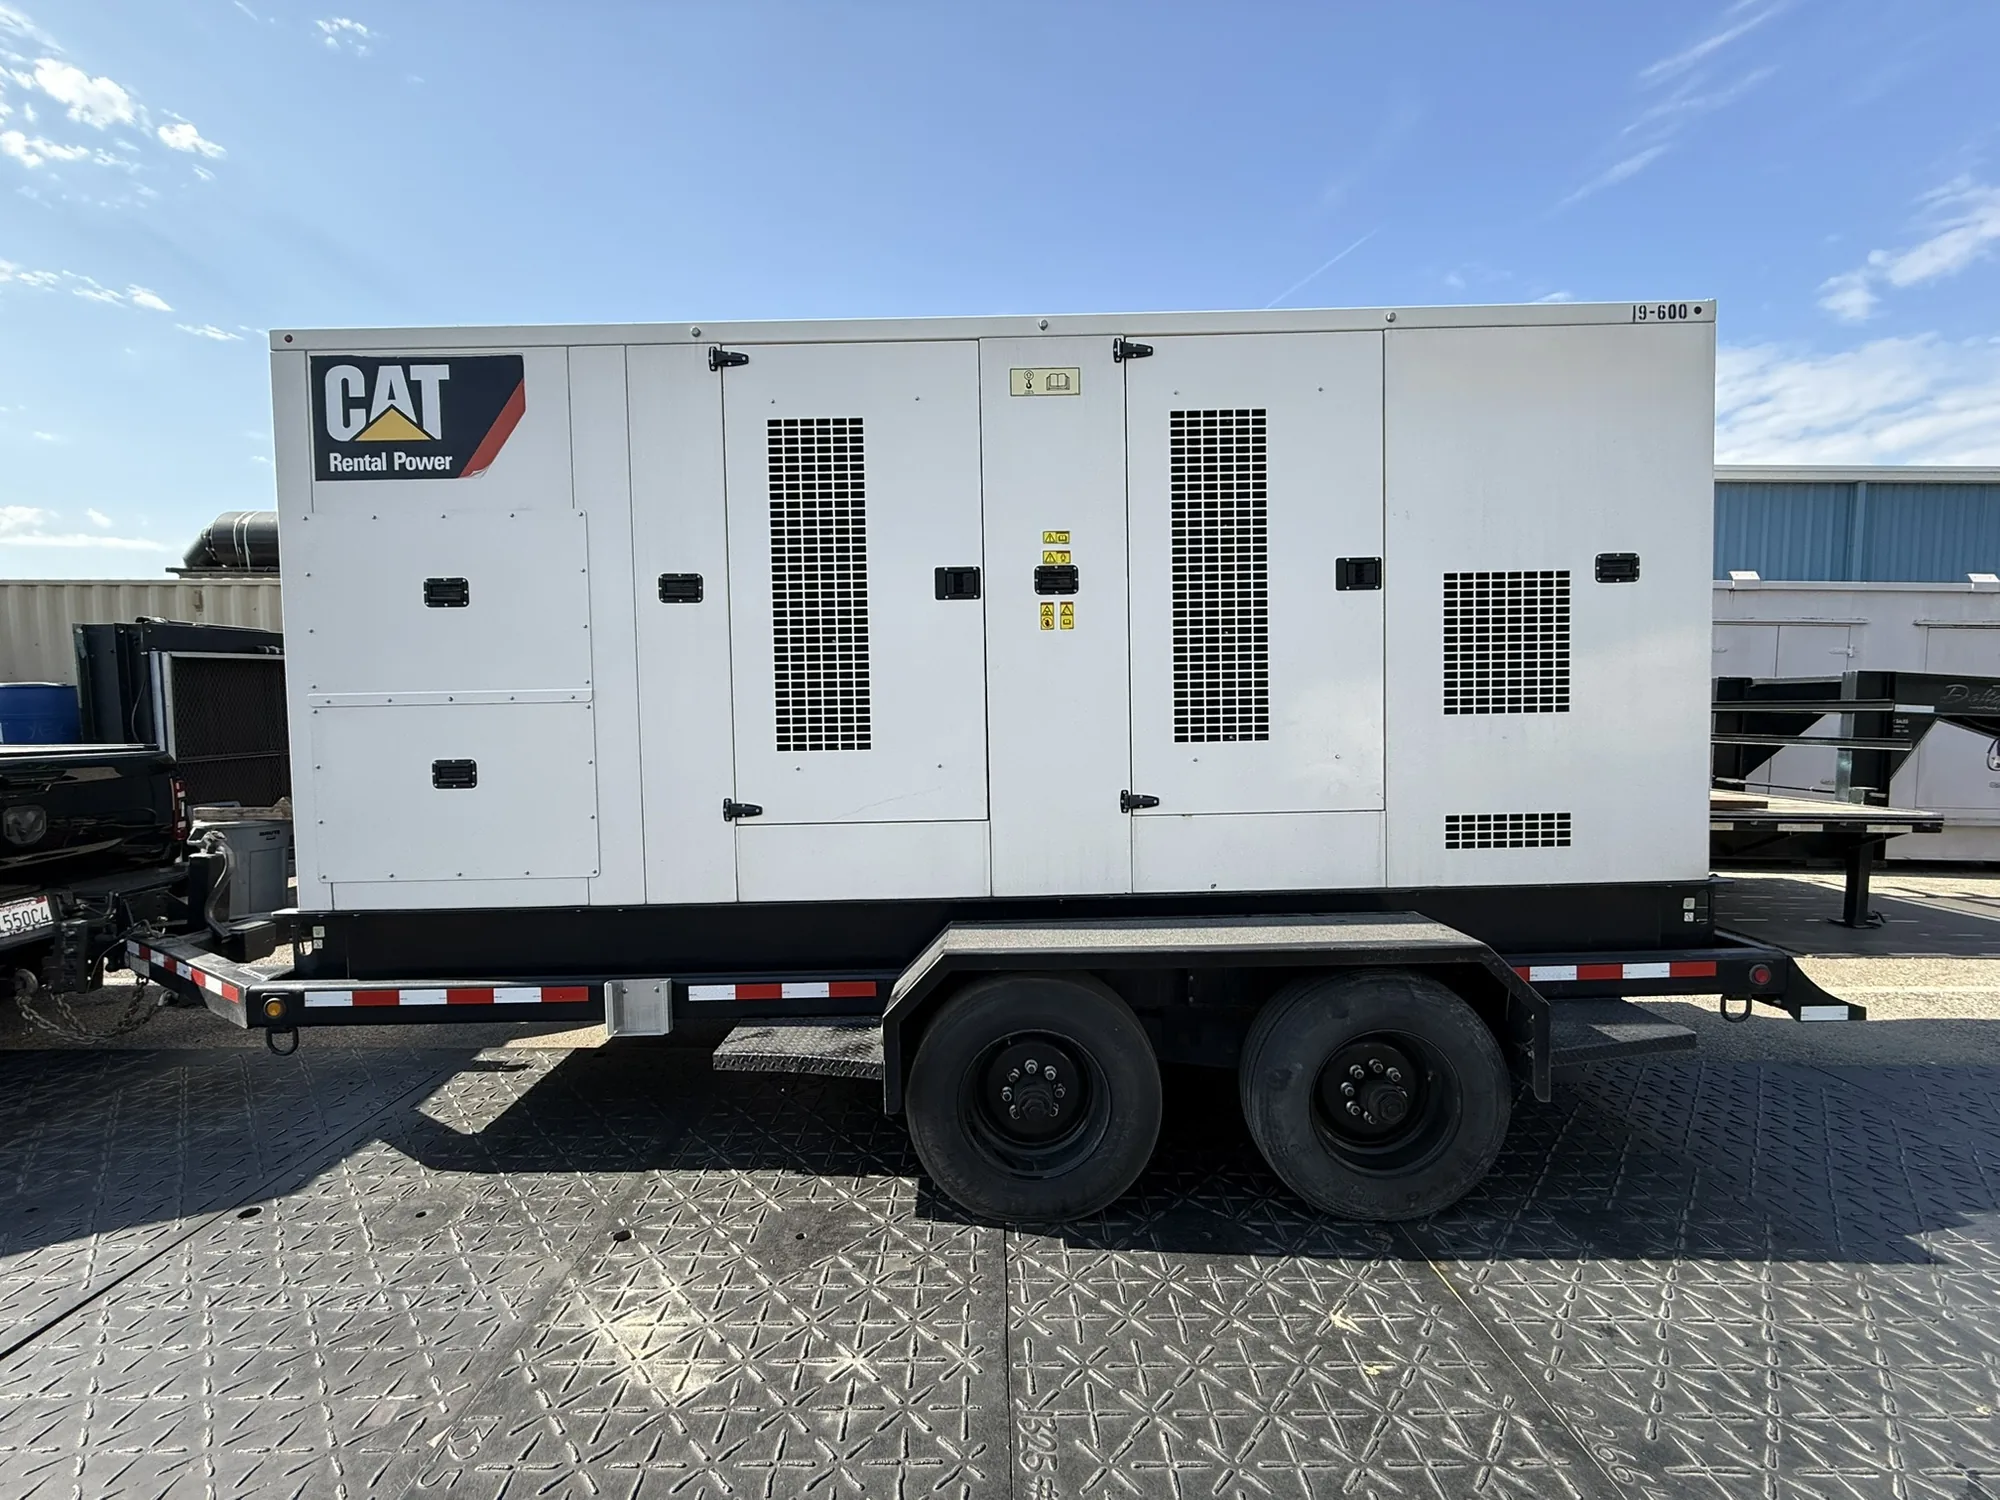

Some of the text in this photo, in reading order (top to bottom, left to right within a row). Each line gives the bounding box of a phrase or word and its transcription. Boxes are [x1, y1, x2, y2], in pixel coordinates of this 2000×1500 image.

[324, 364, 450, 442] CAT
[329, 451, 453, 473] Rental Power
[0, 906, 49, 932] 550C4
